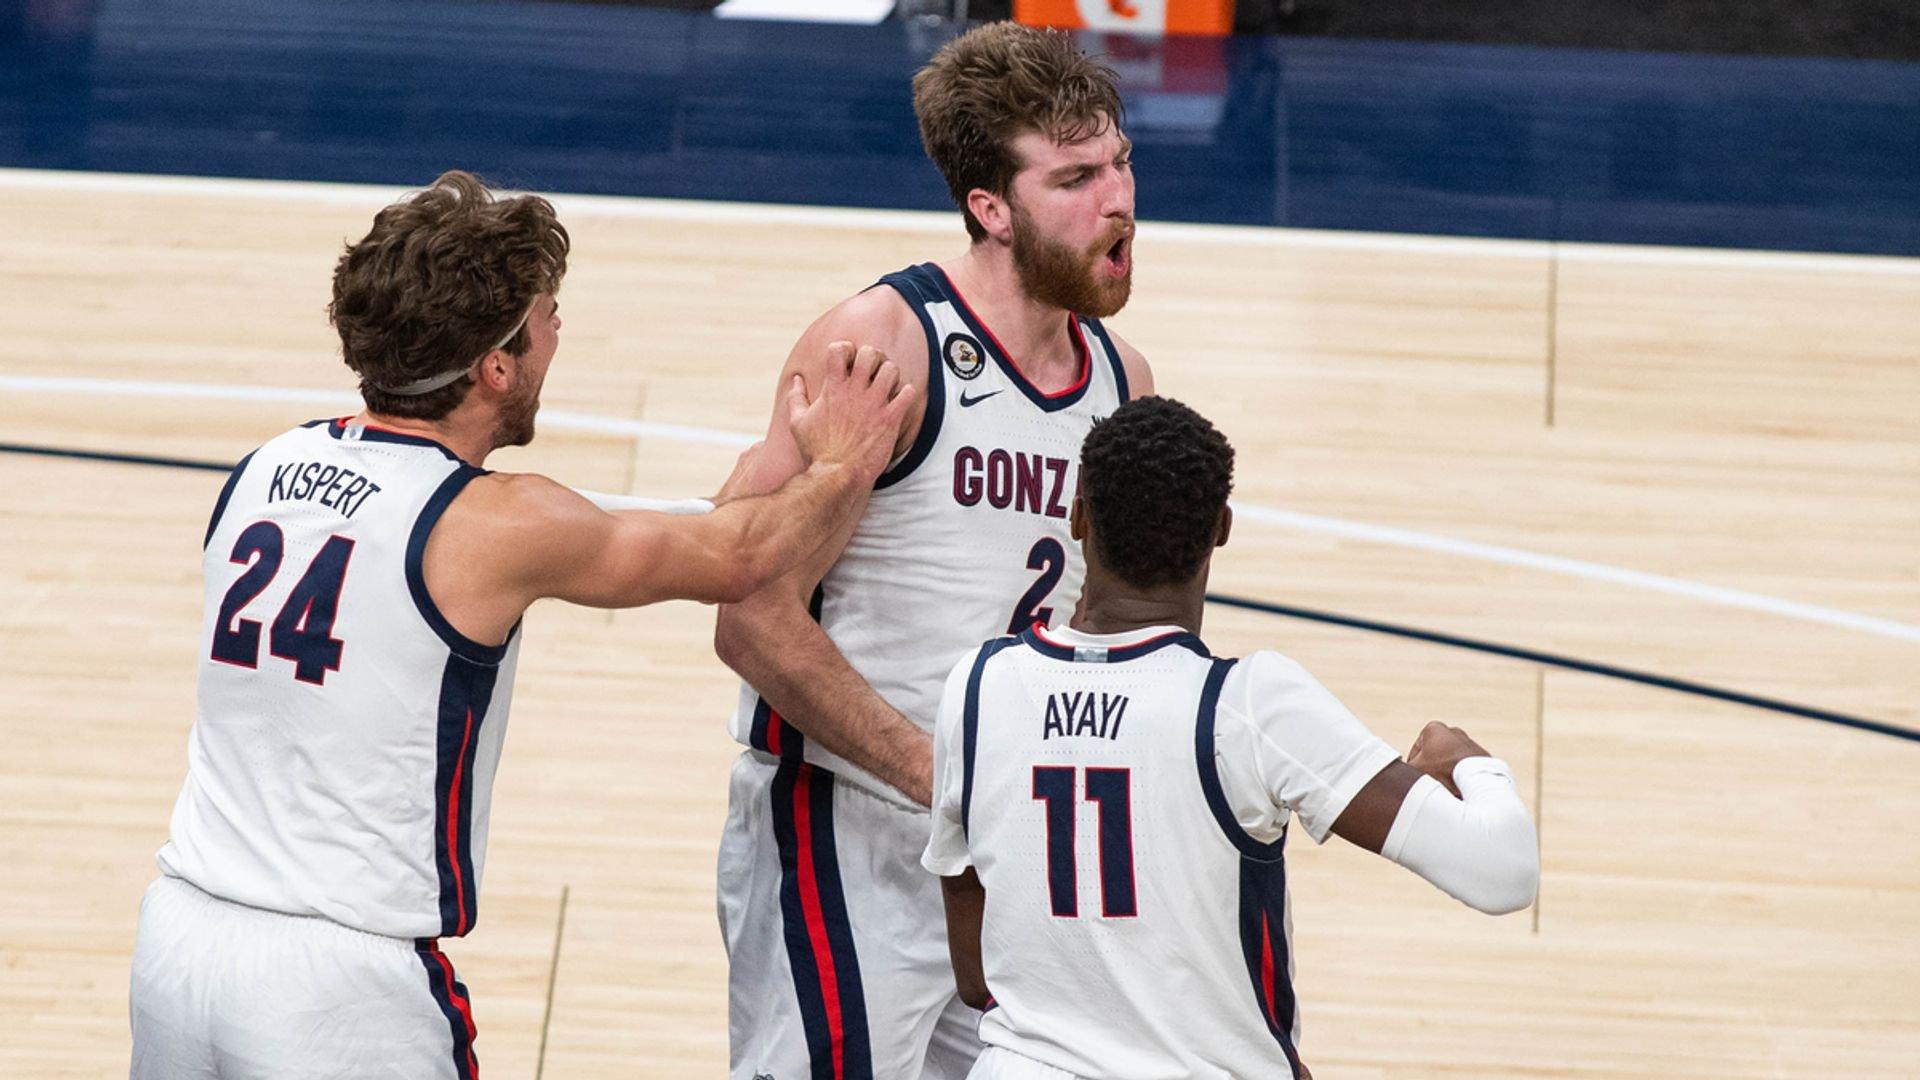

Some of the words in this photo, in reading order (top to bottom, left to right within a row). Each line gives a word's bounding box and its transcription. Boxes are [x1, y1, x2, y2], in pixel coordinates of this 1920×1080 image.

[268, 462, 382, 518] KISPERT
[953, 446, 1083, 519] GONZ
[210, 520, 356, 686] 24
[1006, 536, 1066, 634] 2
[1043, 691, 1129, 740] AYAYI
[1032, 766, 1137, 917] 11
